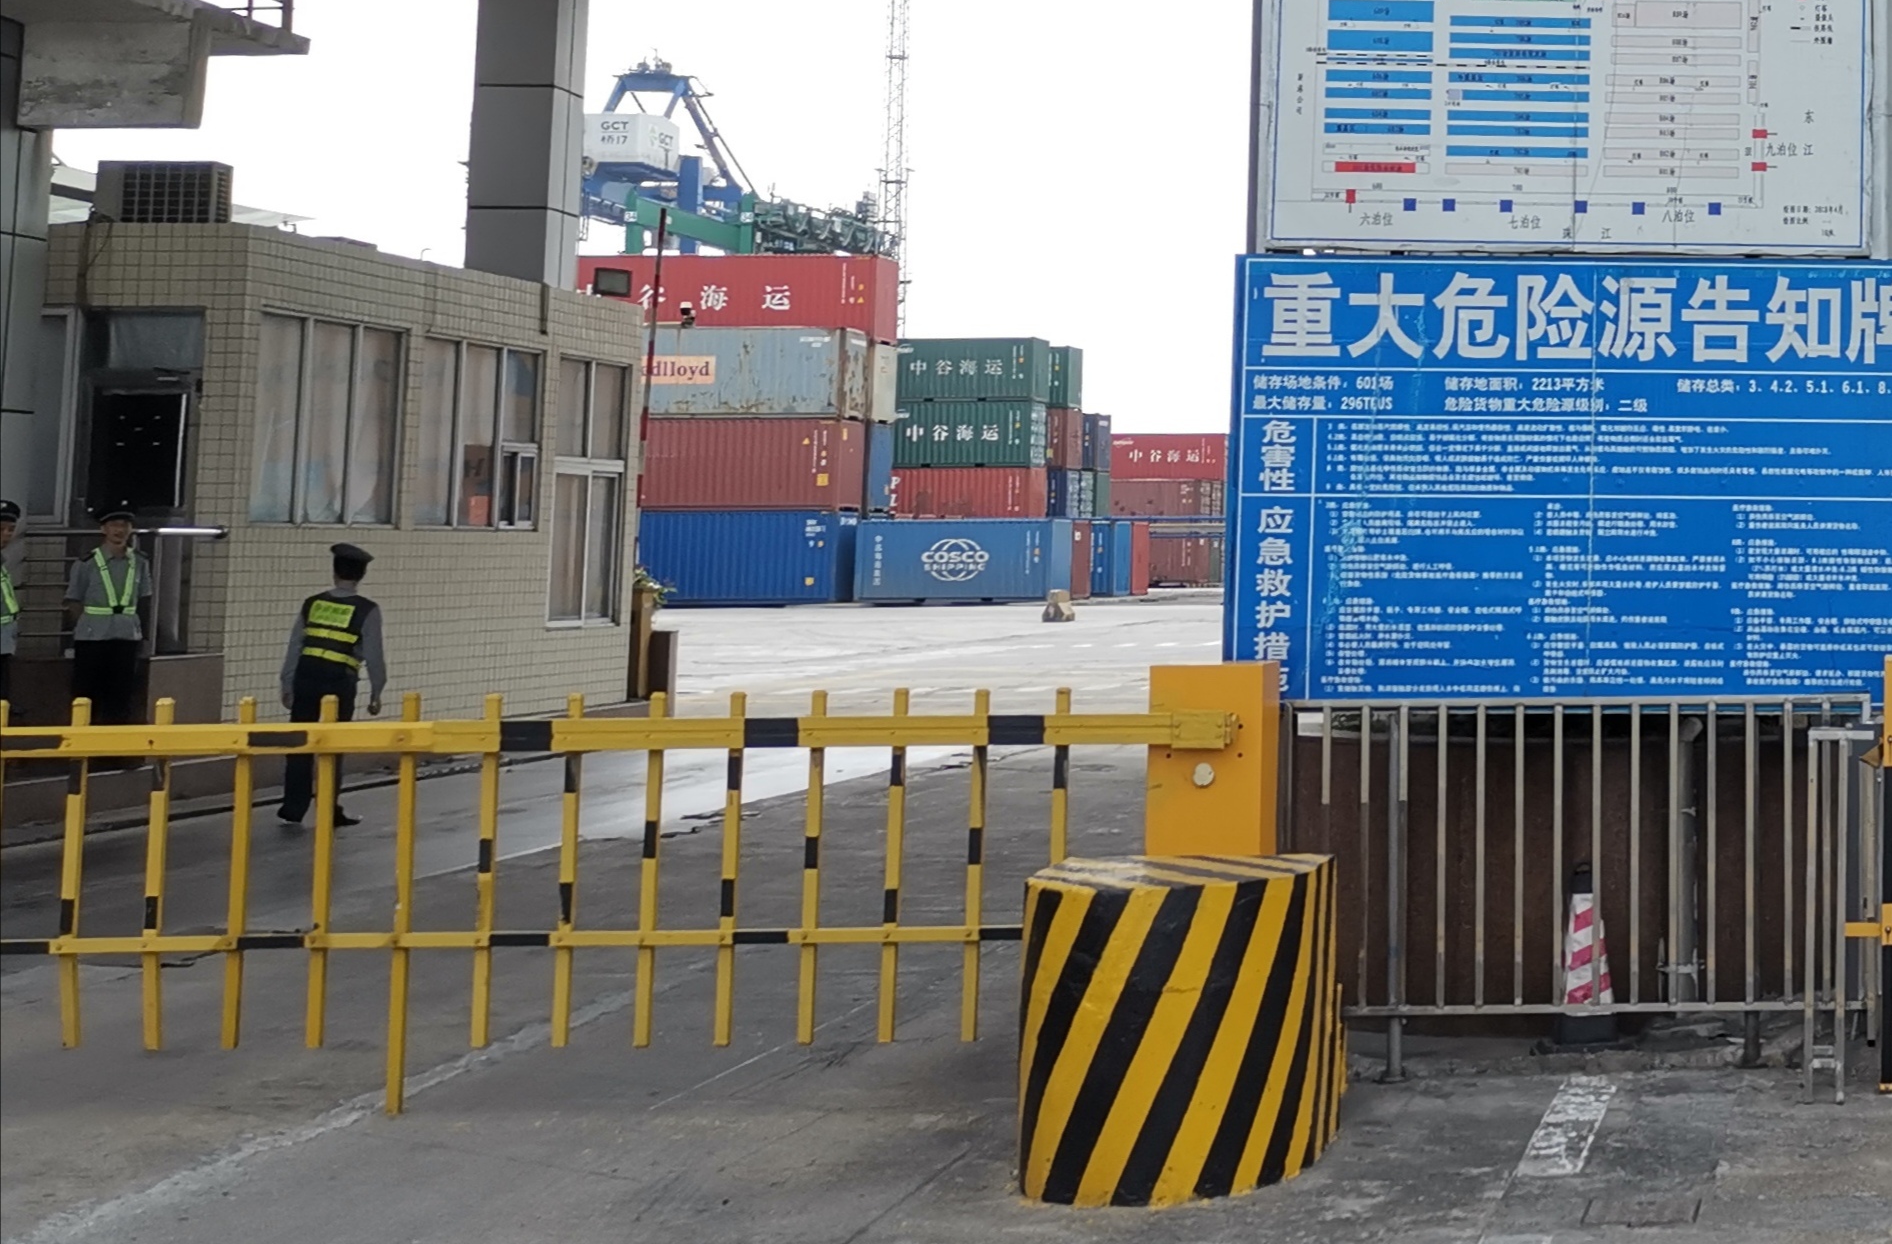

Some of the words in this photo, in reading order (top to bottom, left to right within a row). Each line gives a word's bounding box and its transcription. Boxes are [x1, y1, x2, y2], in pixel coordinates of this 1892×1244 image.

[600, 120, 629, 131] GCT
[1765, 142, 1798, 157] 九泊位
[1359, 211, 1394, 227] 六泊位
[1508, 214, 1541, 230] 七泊位
[1661, 209, 1695, 223] 八泊位
[909, 358, 1004, 376] 中谷海运
[905, 423, 1000, 442] 中谷海运
[1128, 448, 1200, 463] 中谷海运
[1258, 420, 1297, 492] 危害性
[920, 550, 990, 563] COSCO
[923, 563, 986, 571] SHIPPING
